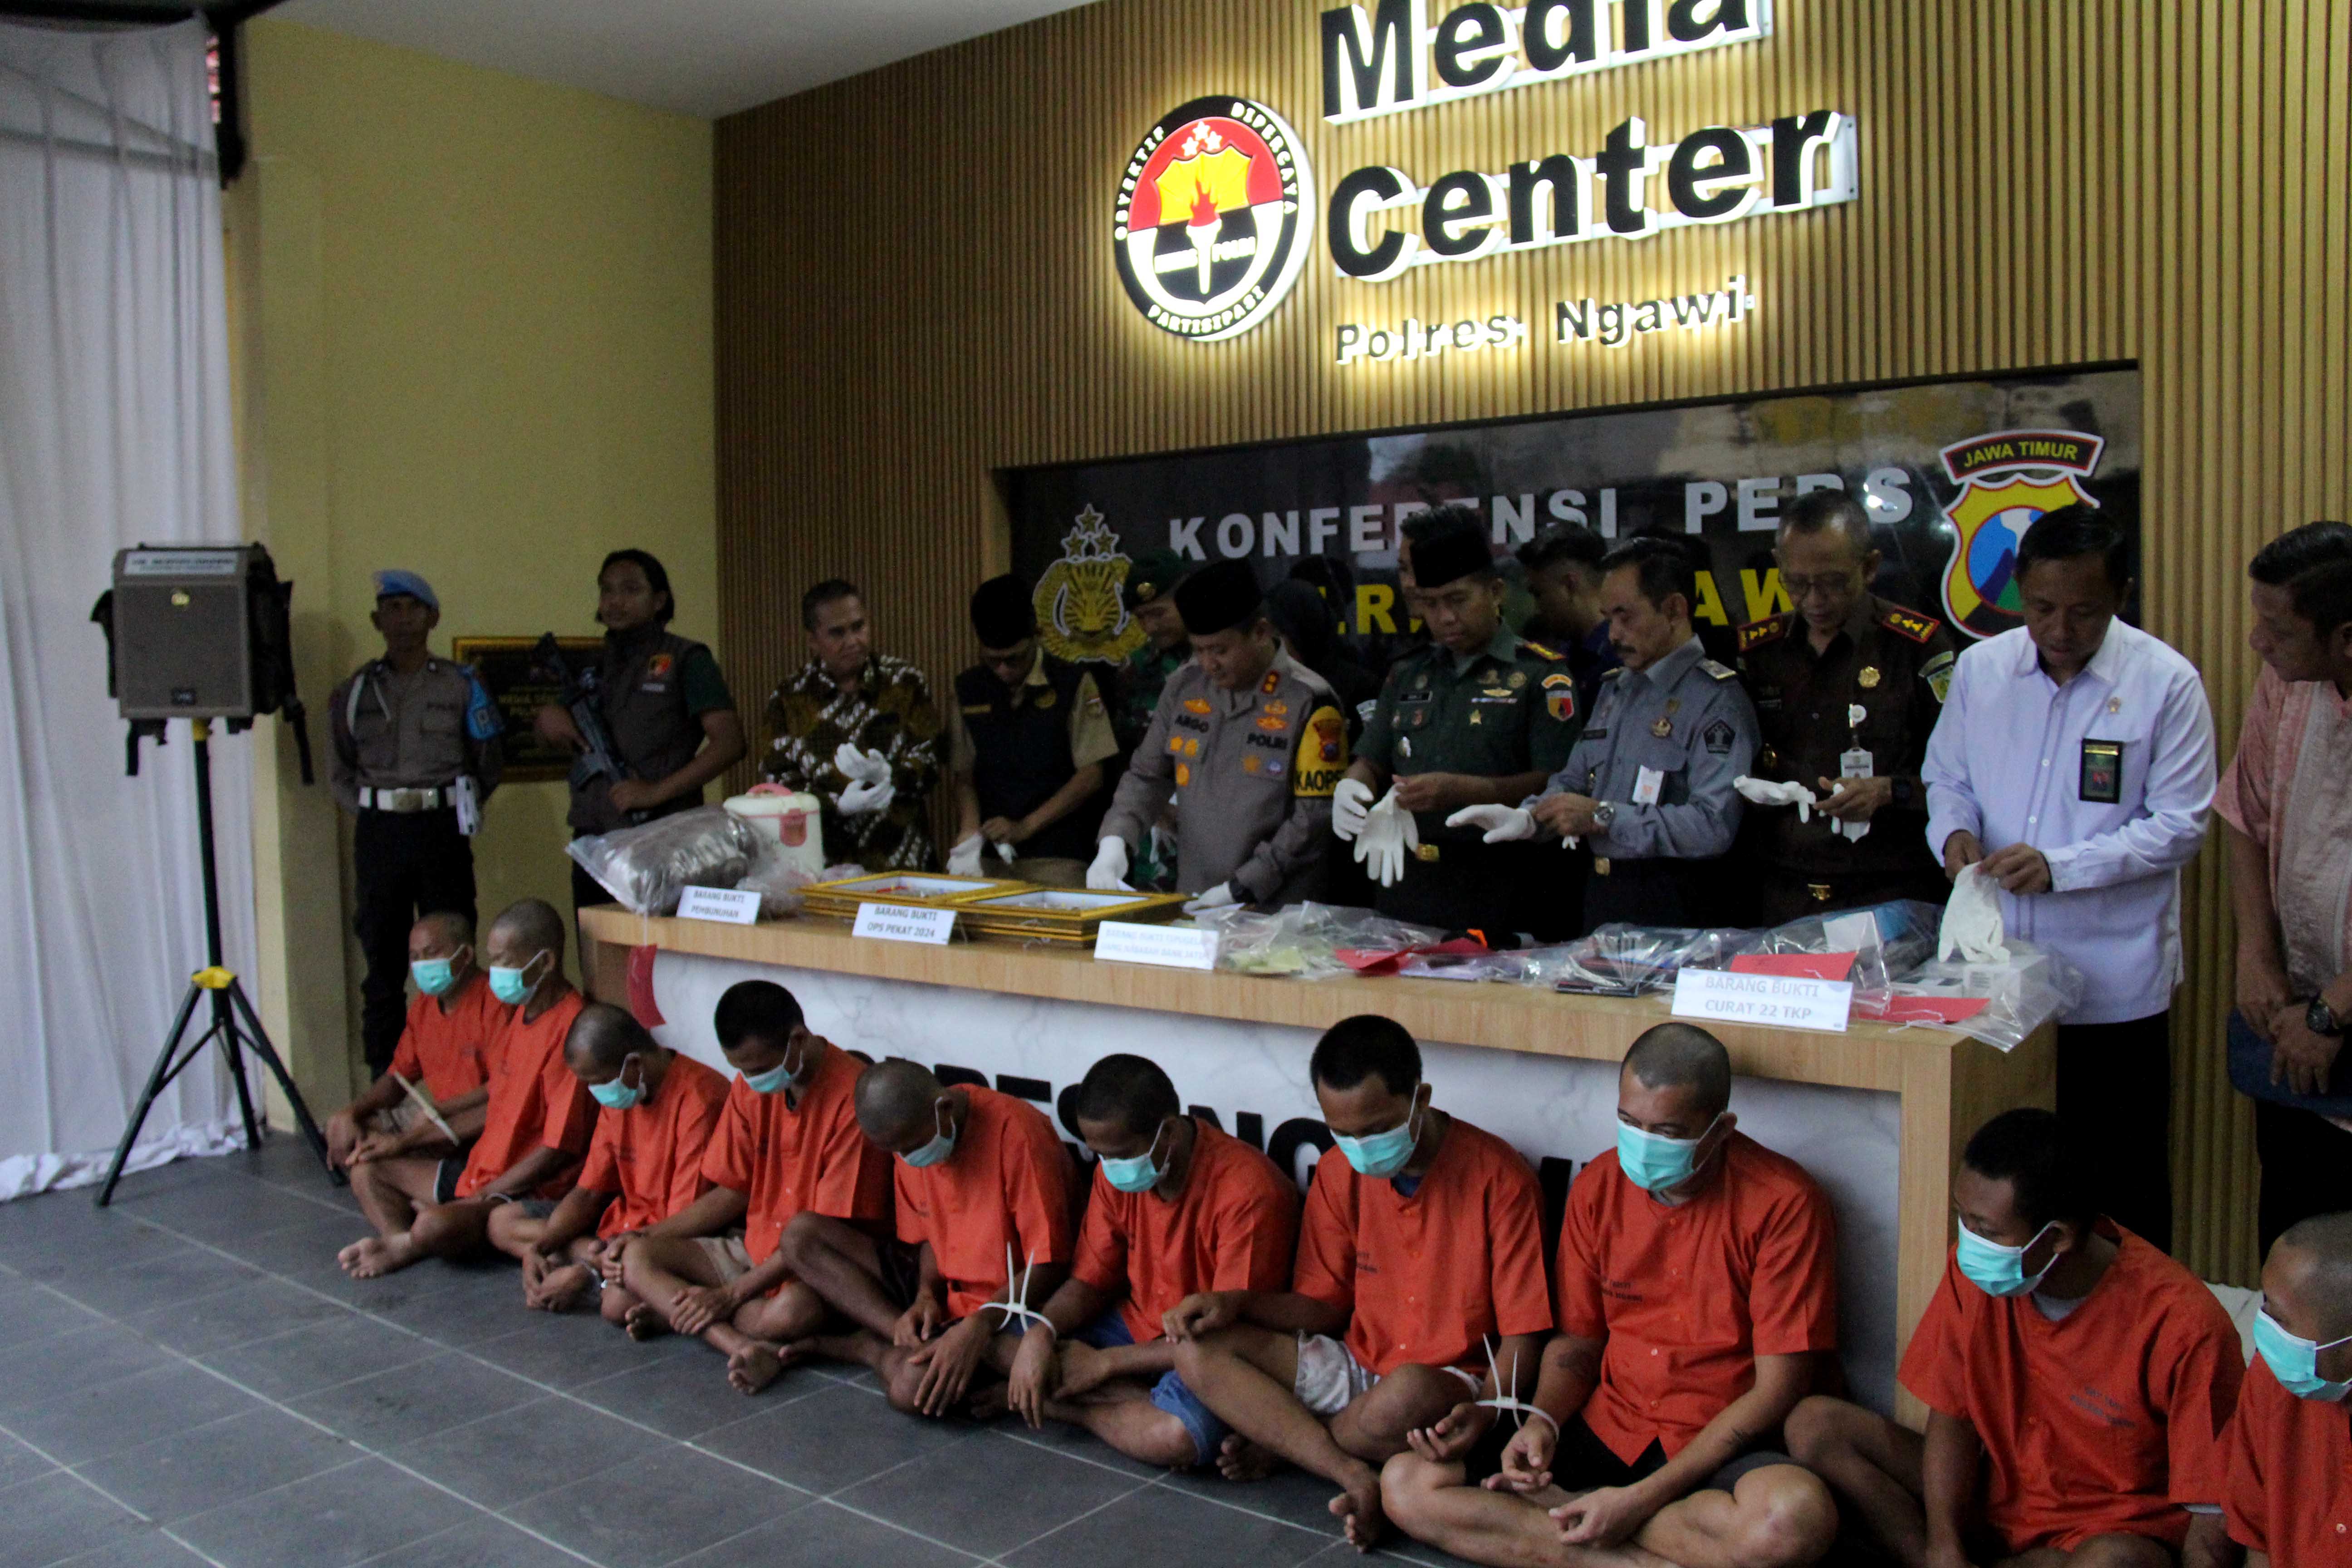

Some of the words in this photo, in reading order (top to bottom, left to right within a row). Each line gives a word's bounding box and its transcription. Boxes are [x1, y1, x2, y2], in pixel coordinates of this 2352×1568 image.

[1231, 102, 1298, 214] DIPERCAYA
[1327, 108, 1841, 281] Center
[1147, 285, 1265, 334] PARTISIPASI
[1336, 314, 1520, 364] Polres
[1557, 275, 1746, 349] Ngawi
[1963, 443, 2014, 468] JAWA
[2019, 440, 2079, 461] TIMUR
[1169, 488, 1617, 562] KONFENSI
[867, 921, 884, 932] OPS
[886, 924, 913, 935] PEKAT
[914, 928, 935, 938] 2024
[874, 906, 910, 918] BARANG
[911, 909, 938, 921] BUKTI
[1705, 975, 1767, 994] BARANG
[1772, 981, 1819, 997] BUKTI
[1705, 999, 1754, 1014] CURAT
[1758, 1004, 1777, 1017] 22
[1783, 1005, 1812, 1020] TKP
